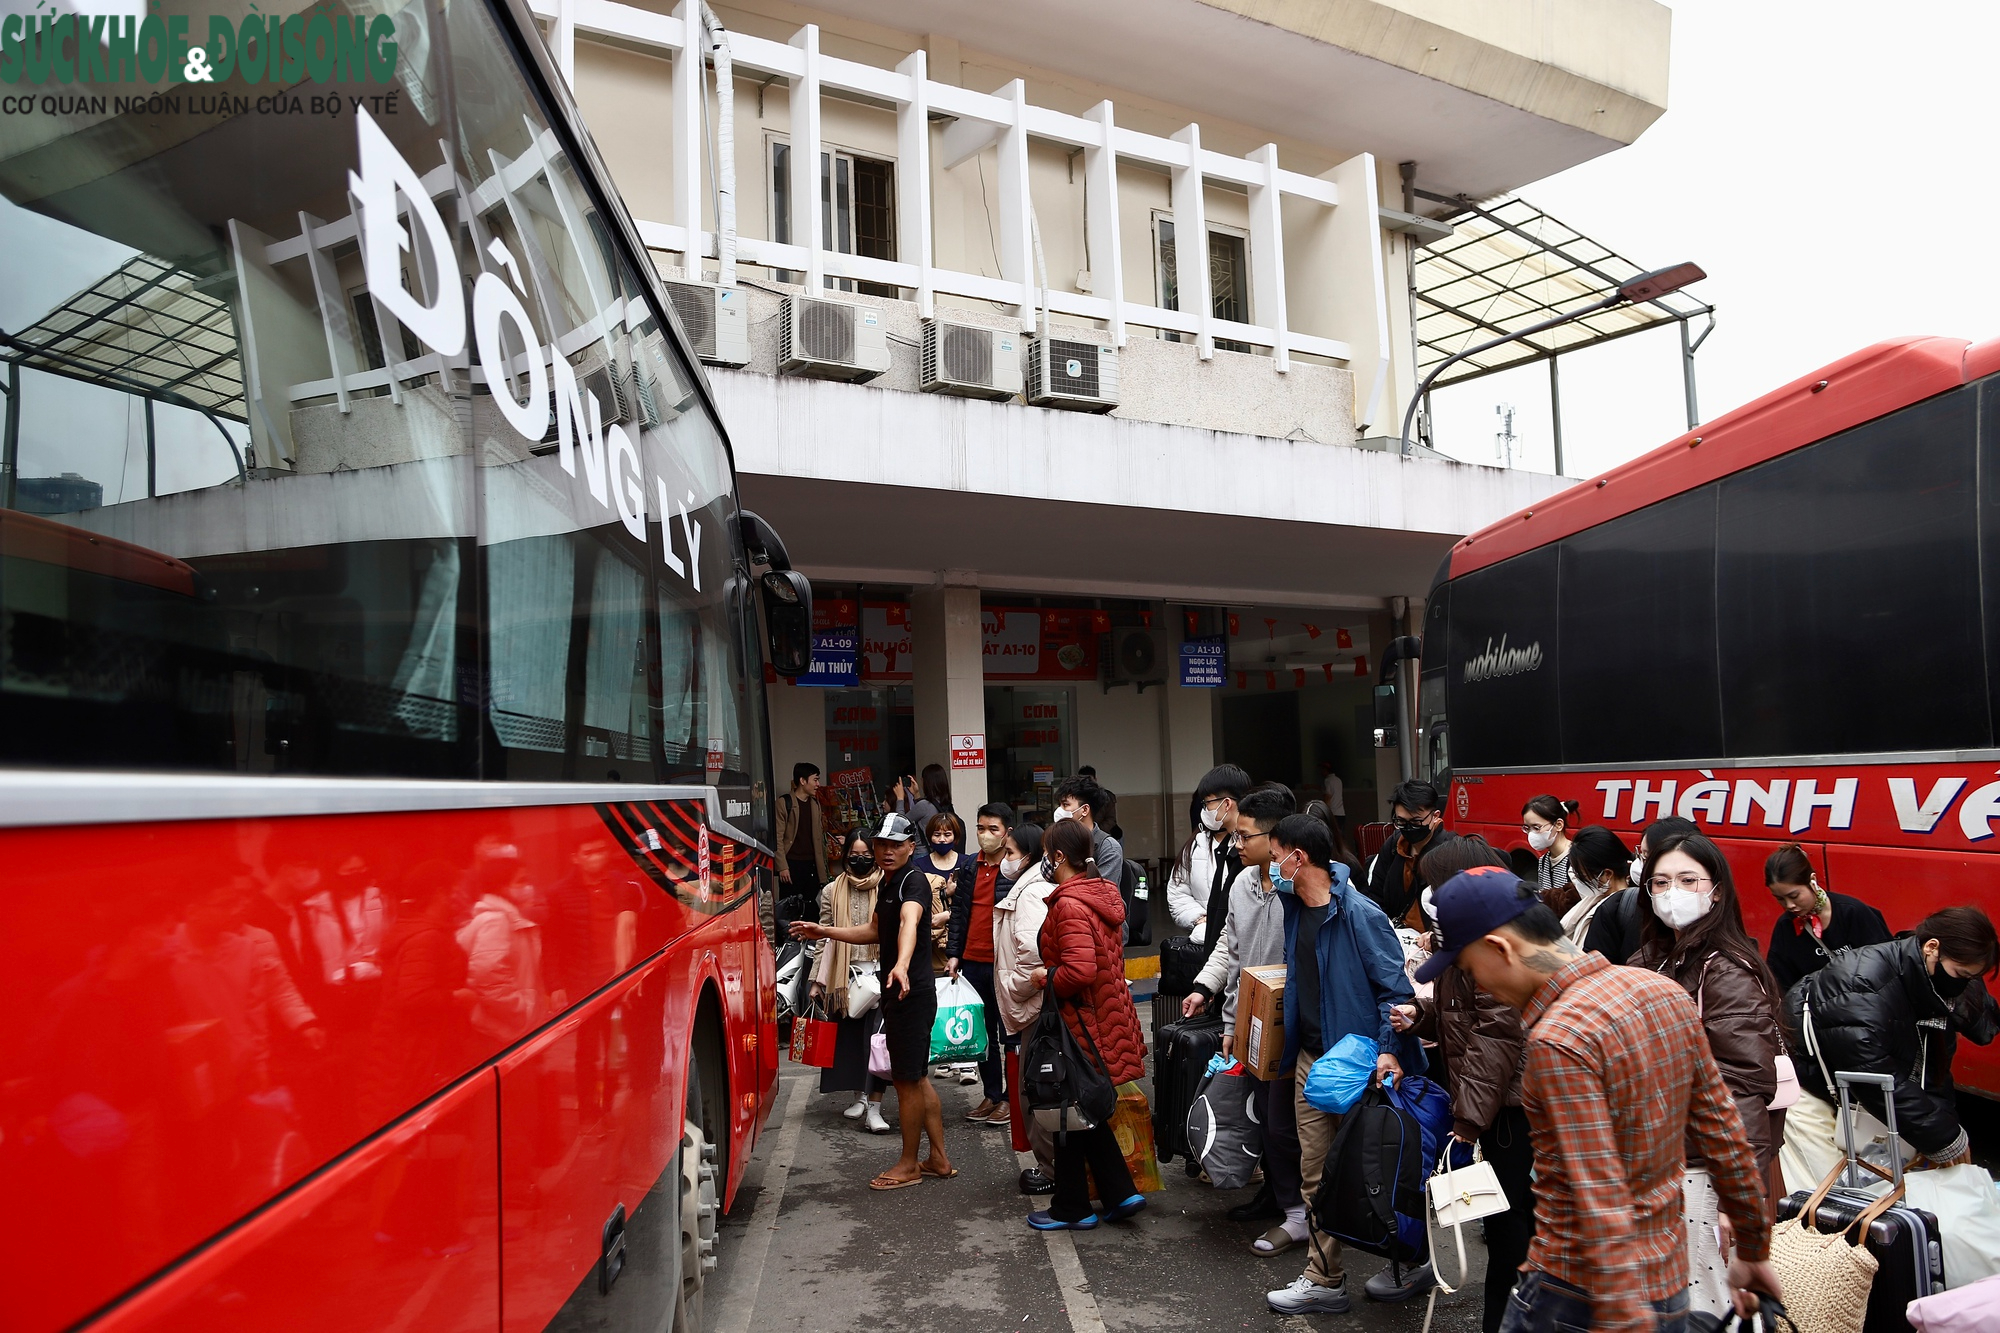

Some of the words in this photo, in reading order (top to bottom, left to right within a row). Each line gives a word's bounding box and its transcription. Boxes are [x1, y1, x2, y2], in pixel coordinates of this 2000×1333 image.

[657, 474, 701, 594] LÝ
[820, 638, 852, 648] A1-09
[981, 640, 1000, 655] ÁT
[1002, 643, 1036, 656] A1-10
[1197, 646, 1221, 654] A1-10
[808, 657, 826, 673] ẨM
[828, 659, 853, 674] THỦY
[1188, 658, 1205, 667] NGỌC
[1463, 632, 1544, 684] mobihome
[1189, 667, 1205, 675] QUAN
[1023, 704, 1058, 719] CƠM
[1023, 725, 1060, 744] PHỞ
[838, 770, 865, 786] Oishi
[1595, 769, 1859, 834] THÀNH
